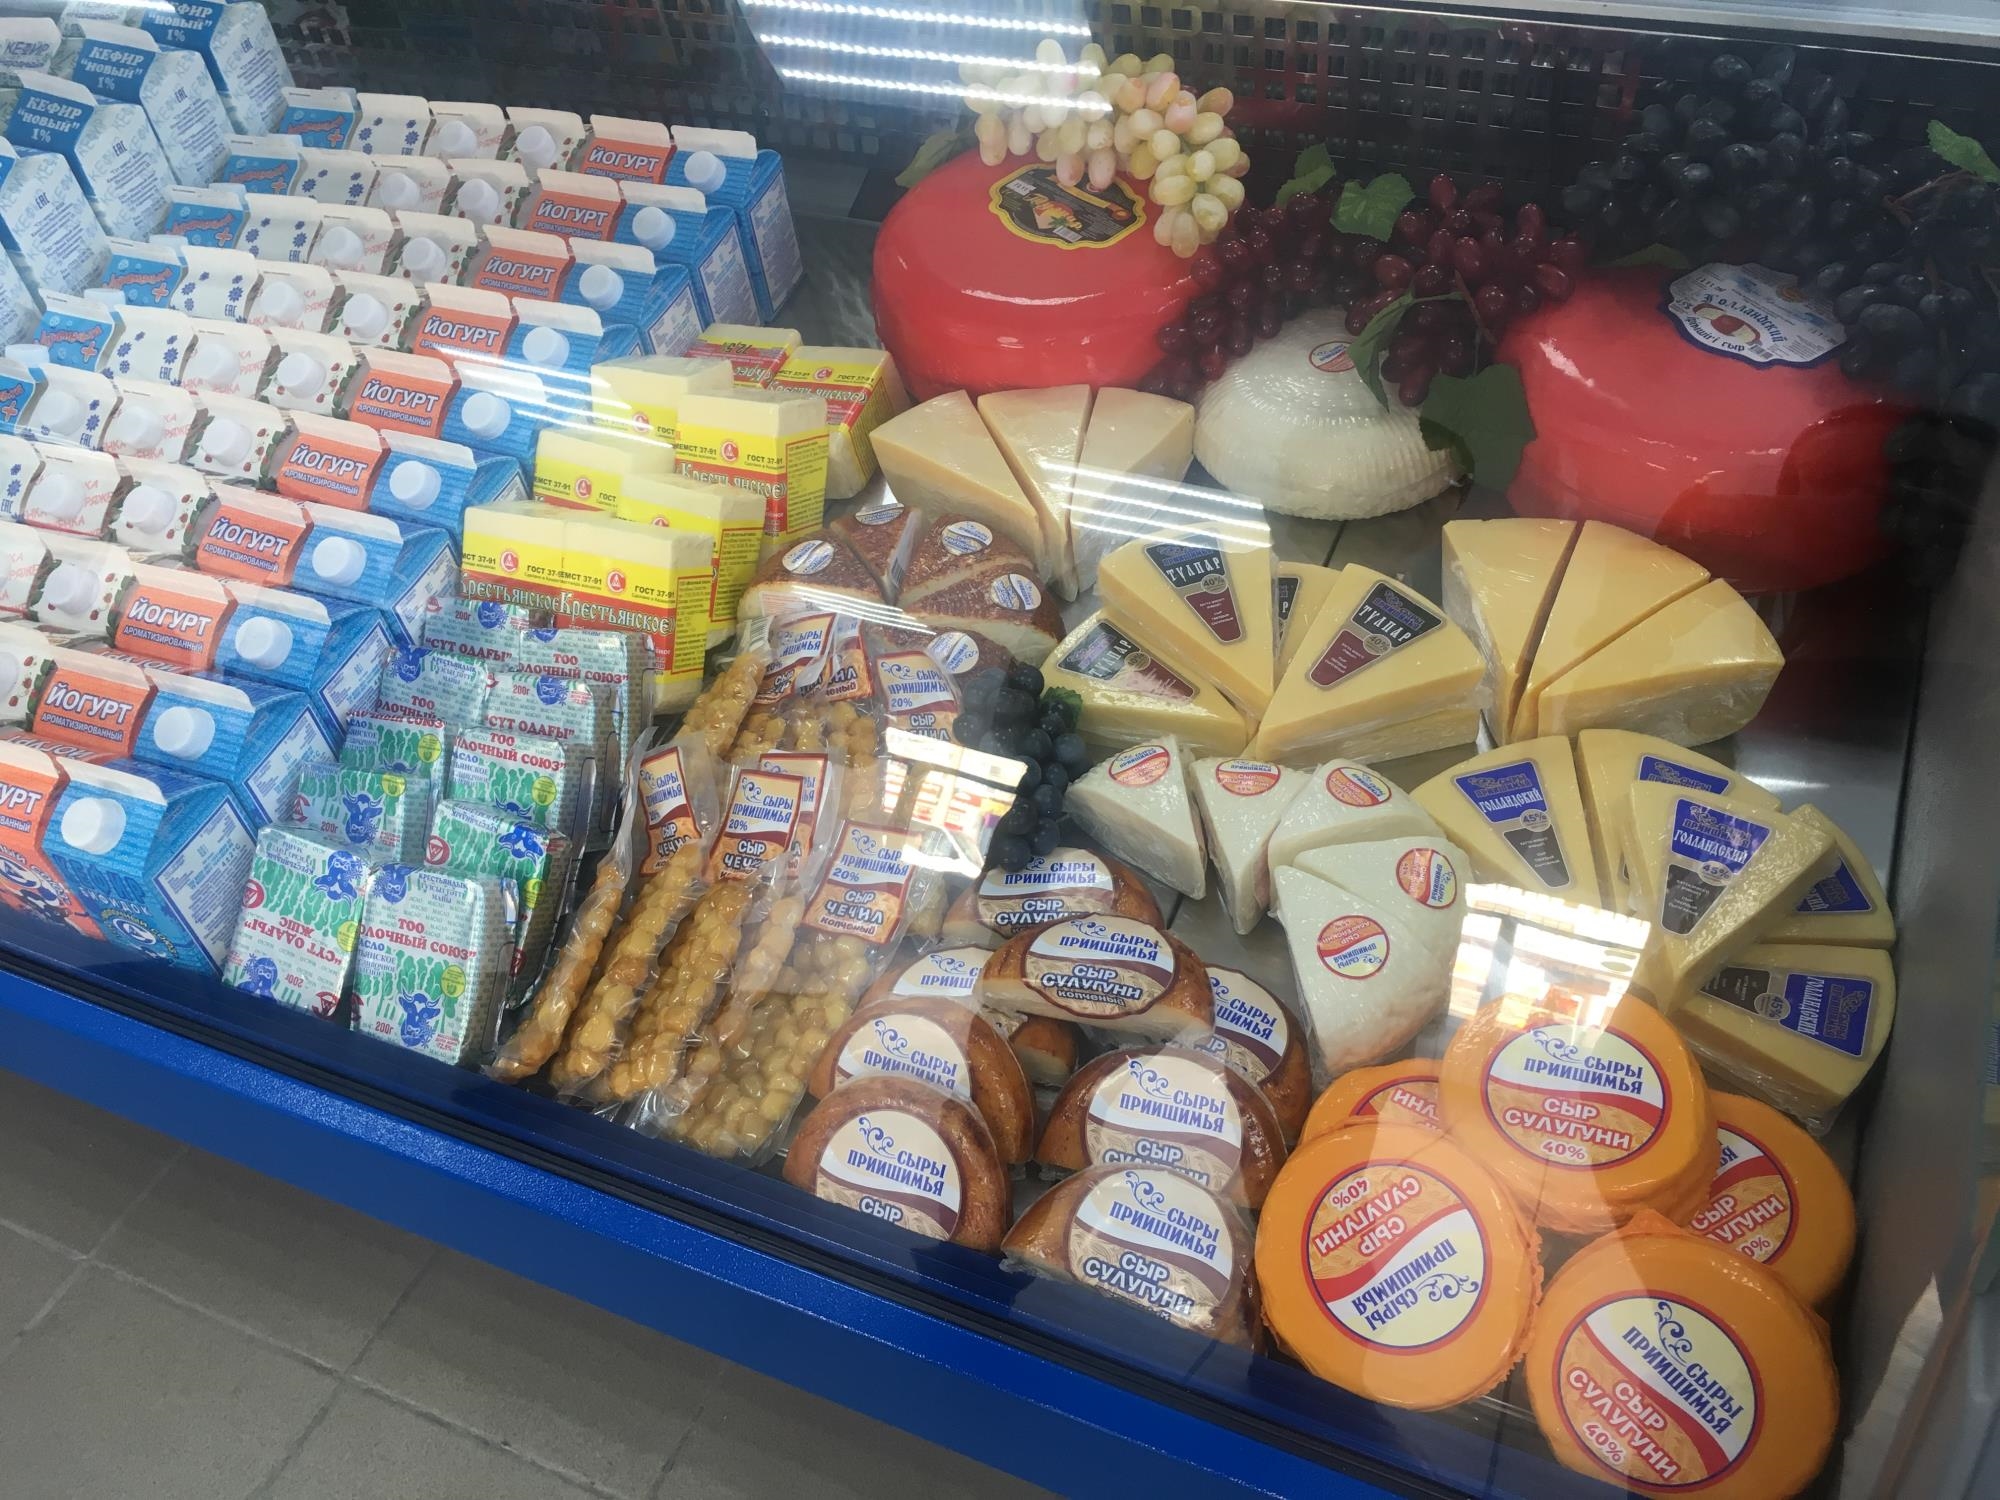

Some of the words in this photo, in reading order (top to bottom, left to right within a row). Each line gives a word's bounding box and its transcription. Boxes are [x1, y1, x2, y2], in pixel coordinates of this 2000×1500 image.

[89, 46, 144, 64] КЕФИР
[97, 77, 115, 90] 1%
[27, 96, 82, 118] КЕФИР
[31, 128, 51, 143] 1%
[590, 147, 659, 173] ЙОГУРТ
[537, 200, 608, 226] ЙОГУРТ
[485, 256, 555, 283] ЙОГУРТ
[423, 316, 500, 347] ЙОГУРТ
[361, 379, 438, 413] ЙОГУРТ
[358, 404, 431, 427] АРОМАТИЗИРОВАННЫЙ
[657, 426, 675, 435] ГОСТ
[290, 446, 367, 480] ЙОГУРТ
[747, 454, 766, 464] ГОСТ
[284, 469, 358, 495] АРОМАТИЗИРОВАННЫЙ
[553, 480, 571, 490] 37-91
[599, 492, 616, 502] ГОСТ
[209, 519, 288, 555] ЙОГУРТ
[204, 543, 279, 573] АРОМАТИЗИРОВАННЫЙ
[481, 556, 497, 566] 37-91
[527, 564, 543, 574] ГОСТ
[584, 574, 603, 585] 37-91
[634, 584, 651, 595] ГОСТ
[129, 597, 212, 636] ЙОГУРТ
[123, 625, 203, 652] АРОМАТИЗИРОВАННЫЙ
[519, 662, 581, 679] ОЛОЧНЫЙ
[553, 653, 579, 666] ТОО
[45, 682, 133, 724] ЙОГУРТ
[411, 695, 435, 710] ТОО
[891, 698, 912, 708] 20%
[41, 711, 123, 743] АРОМАТИЗИРОВАННЫЙ
[910, 713, 935, 726] СЫР
[490, 732, 515, 747] ТОО
[656, 771, 679, 789] СЫРЫ
[0, 780, 41, 815] УРТ
[763, 795, 793, 810] СЫРЫ
[1479, 789, 1543, 812] ГОЛЛАНДСКИЙ
[729, 819, 748, 831] 20%
[732, 803, 791, 824] ПРИИШИМЬЯ
[321, 821, 338, 834] 200г
[737, 840, 766, 856] СЫР
[877, 848, 902, 862] СЫР
[1674, 830, 1749, 864] ГОЛЛАНДСКИЙ
[832, 867, 860, 882] 20%
[840, 854, 909, 876] ПРИИШИМЬЯ
[1050, 862, 1095, 873] СЫРЫ
[1702, 865, 1730, 879] 45%
[1005, 871, 1096, 885] ПРИИШИМЬЯ
[844, 890, 875, 904] СЫР
[1022, 899, 1064, 913] СЫР
[825, 899, 884, 925] ЧЕЧИЛ
[360, 924, 427, 950] ОЛОЧНЫЙ
[399, 918, 425, 933] ТОО
[360, 939, 385, 951] АСЛО
[1059, 935, 1158, 962] ПРИИШИМЬЯ
[1110, 932, 1159, 950] СЫРЫ
[920, 975, 975, 989] ПРИИШ
[1072, 964, 1118, 981] СЫР
[1041, 973, 1142, 1000] СУЛУГУНИ
[1229, 998, 1277, 1028] СЫРЫ
[375, 1020, 394, 1034] 200г
[863, 1050, 956, 1091] ПРИИШИМЬЯ
[910, 1051, 958, 1076] СЫРЫ
[1584, 1055, 1644, 1079] СЫРЫ
[1523, 1058, 1643, 1095] ПРИИШИМЬЯ
[1119, 1093, 1224, 1133] ПРИИШИМЬЯ
[1172, 1090, 1226, 1115] СЫРЫ
[1543, 1098, 1599, 1120] СЫР
[1503, 1108, 1632, 1151] СУЛУГУНИ
[1135, 1139, 1184, 1163] СЫР
[1542, 1140, 1586, 1160] 40%
[847, 1150, 944, 1197] ПРИИШИМЬЯ
[896, 1150, 947, 1178] СЫРЫ
[1332, 1177, 1369, 1208] 40%
[859, 1196, 903, 1222] СЫР
[1314, 1175, 1421, 1257] СУЛУГУНИ
[1692, 1196, 1736, 1231] СЫР
[1109, 1201, 1217, 1261] ПРИИШИМЬЯ
[1166, 1207, 1220, 1243] СЫРЫ
[1360, 1215, 1406, 1256] СЫР
[1120, 1251, 1171, 1282] СЫР
[1351, 1238, 1457, 1316] ПРИИШИМЬЯ
[1083, 1256, 1193, 1316] СУЛУГУНИ
[1364, 1288, 1419, 1331] СЫРЫ
[1622, 1326, 1733, 1436] ПРИИШИМЬЯ
[1686, 1362, 1744, 1418] СЫРЫ
[1614, 1380, 1667, 1431] СЫР
[1568, 1367, 1681, 1480] СУЛУГУНИ
[1583, 1422, 1625, 1465] 40%
